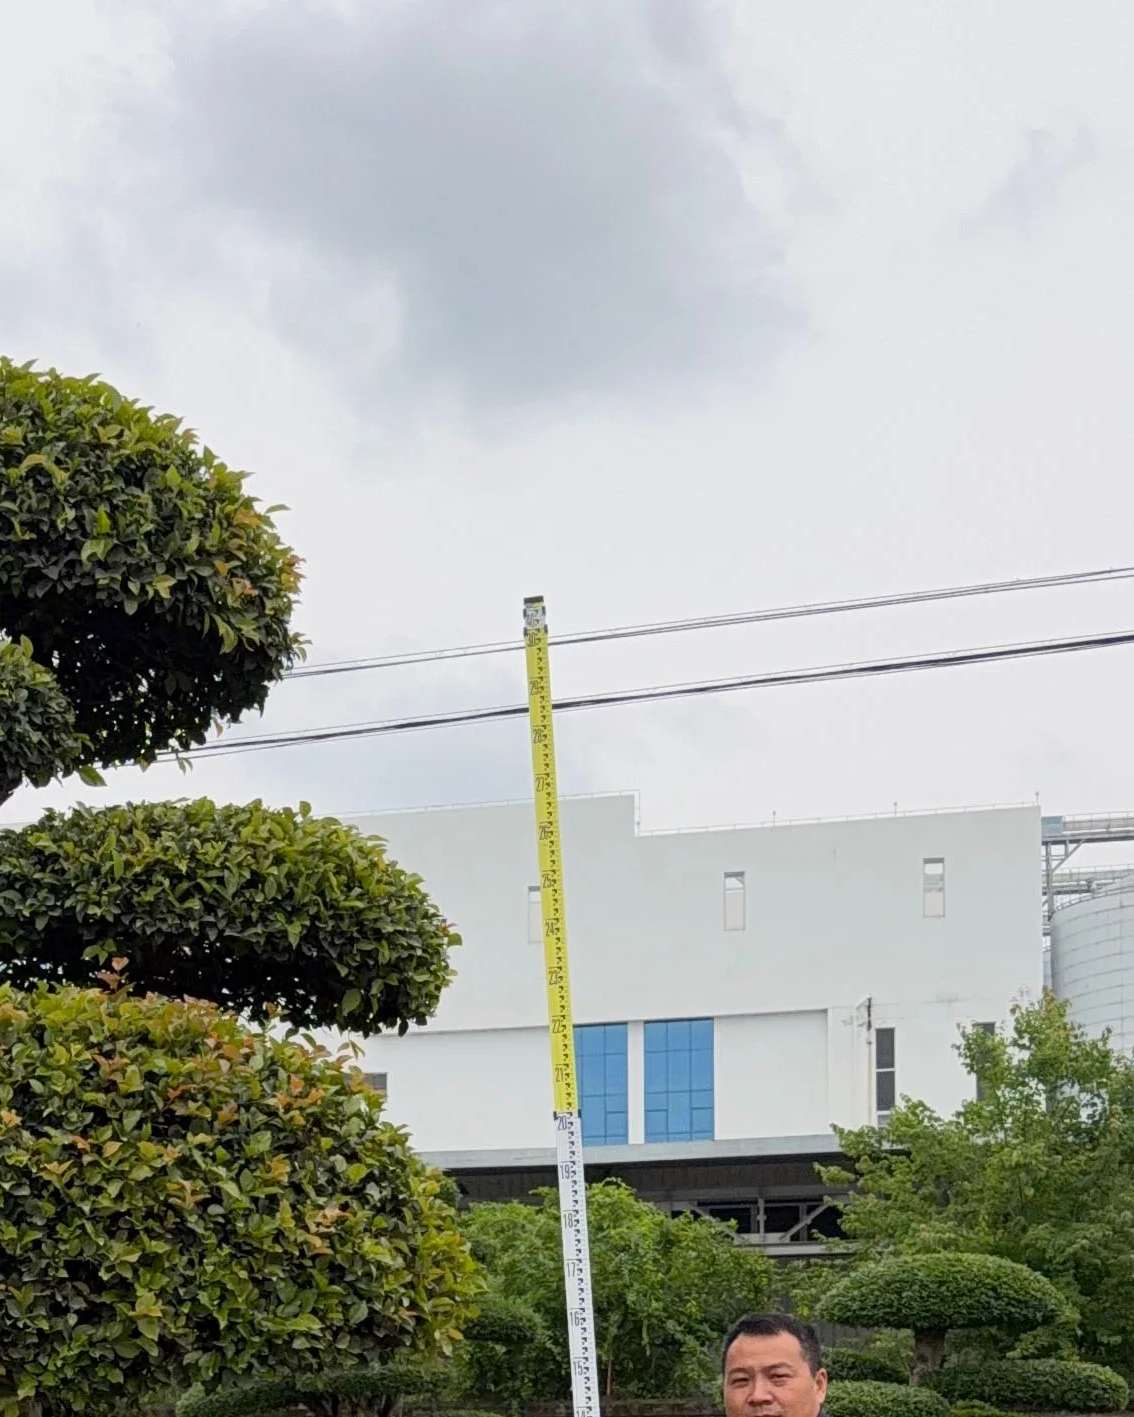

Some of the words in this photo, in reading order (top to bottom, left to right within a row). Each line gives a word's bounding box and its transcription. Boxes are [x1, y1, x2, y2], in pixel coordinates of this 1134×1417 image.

[530, 680, 539, 695] 29
[533, 729, 543, 743] 28
[536, 777, 545, 792] 27
[539, 825, 549, 840] 26
[542, 873, 552, 888] 25
[545, 922, 555, 937] 24
[549, 970, 558, 985] 23
[552, 1018, 562, 1033] 22
[555, 1067, 564, 1082] 21
[558, 1115, 567, 1130] 20
[560, 1165, 570, 1179] 19
[563, 1213, 573, 1228] 18
[566, 1262, 576, 1277] 17
[570, 1311, 580, 1326] 16
[573, 1361, 583, 1376] 15
